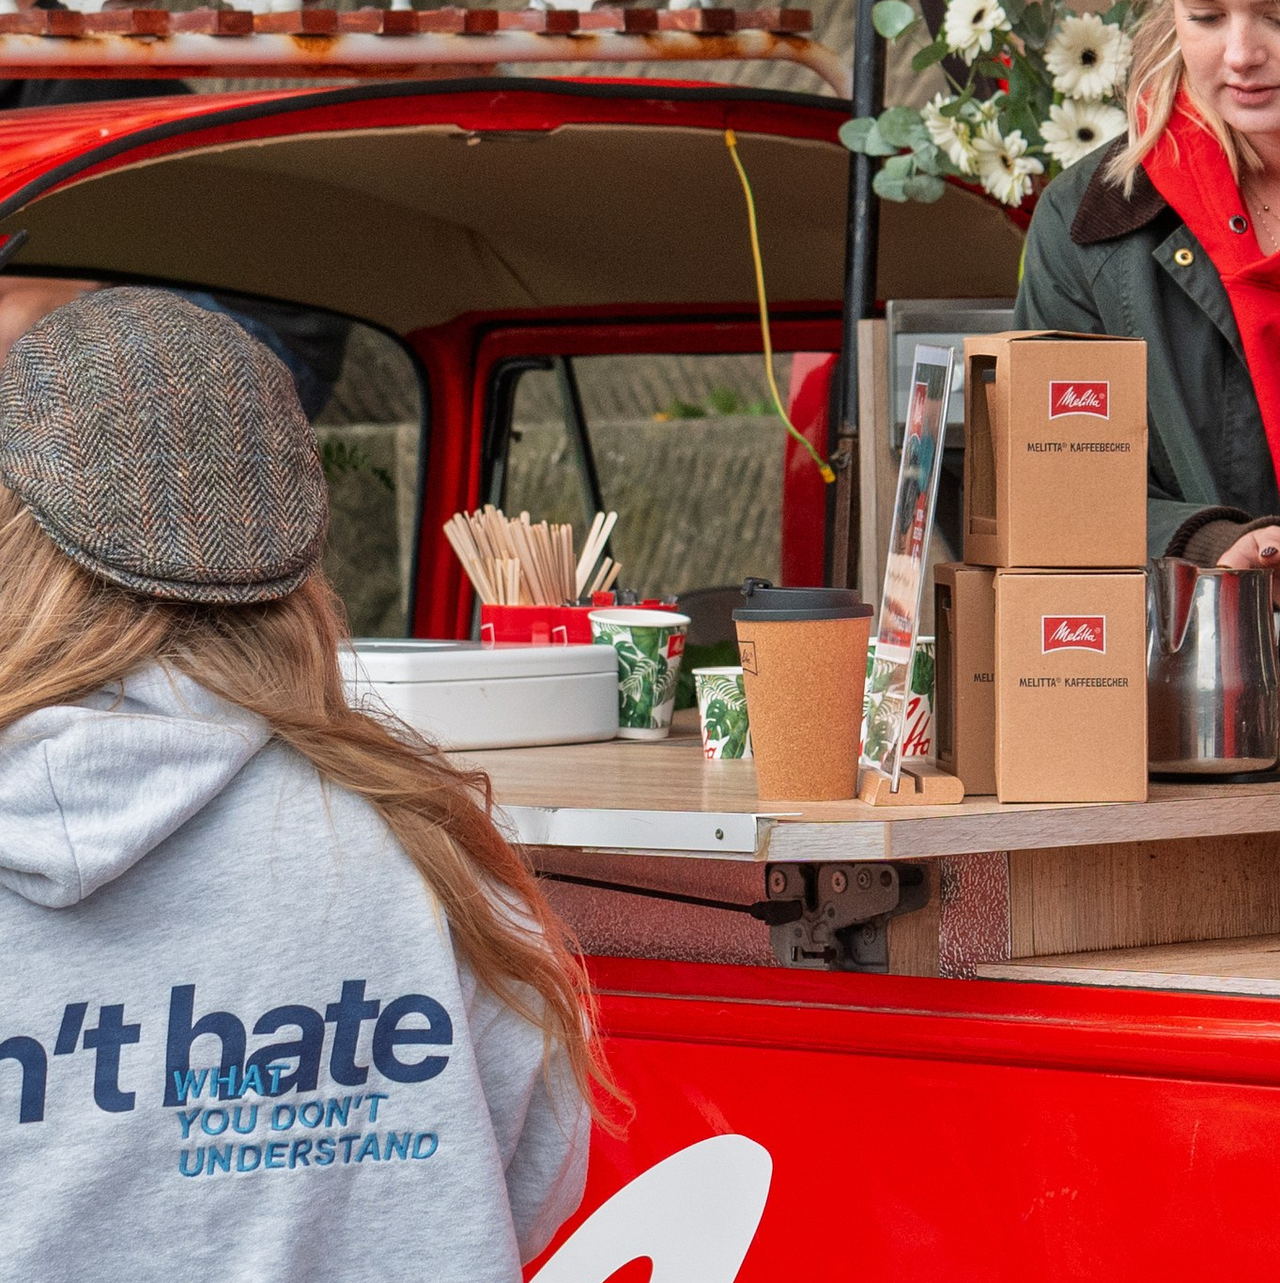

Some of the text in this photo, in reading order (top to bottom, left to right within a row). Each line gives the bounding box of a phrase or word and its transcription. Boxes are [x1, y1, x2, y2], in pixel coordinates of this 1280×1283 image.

[1070, 442, 1131, 453] KAFFEEBECHER
[1064, 677, 1129, 688] KAFFEEBECHER
[162, 979, 454, 1107] hate
[173, 1063, 291, 1102] WHAT
[178, 1092, 389, 1140] YOU DON'T
[178, 1131, 440, 1178] UNDERSTAND
